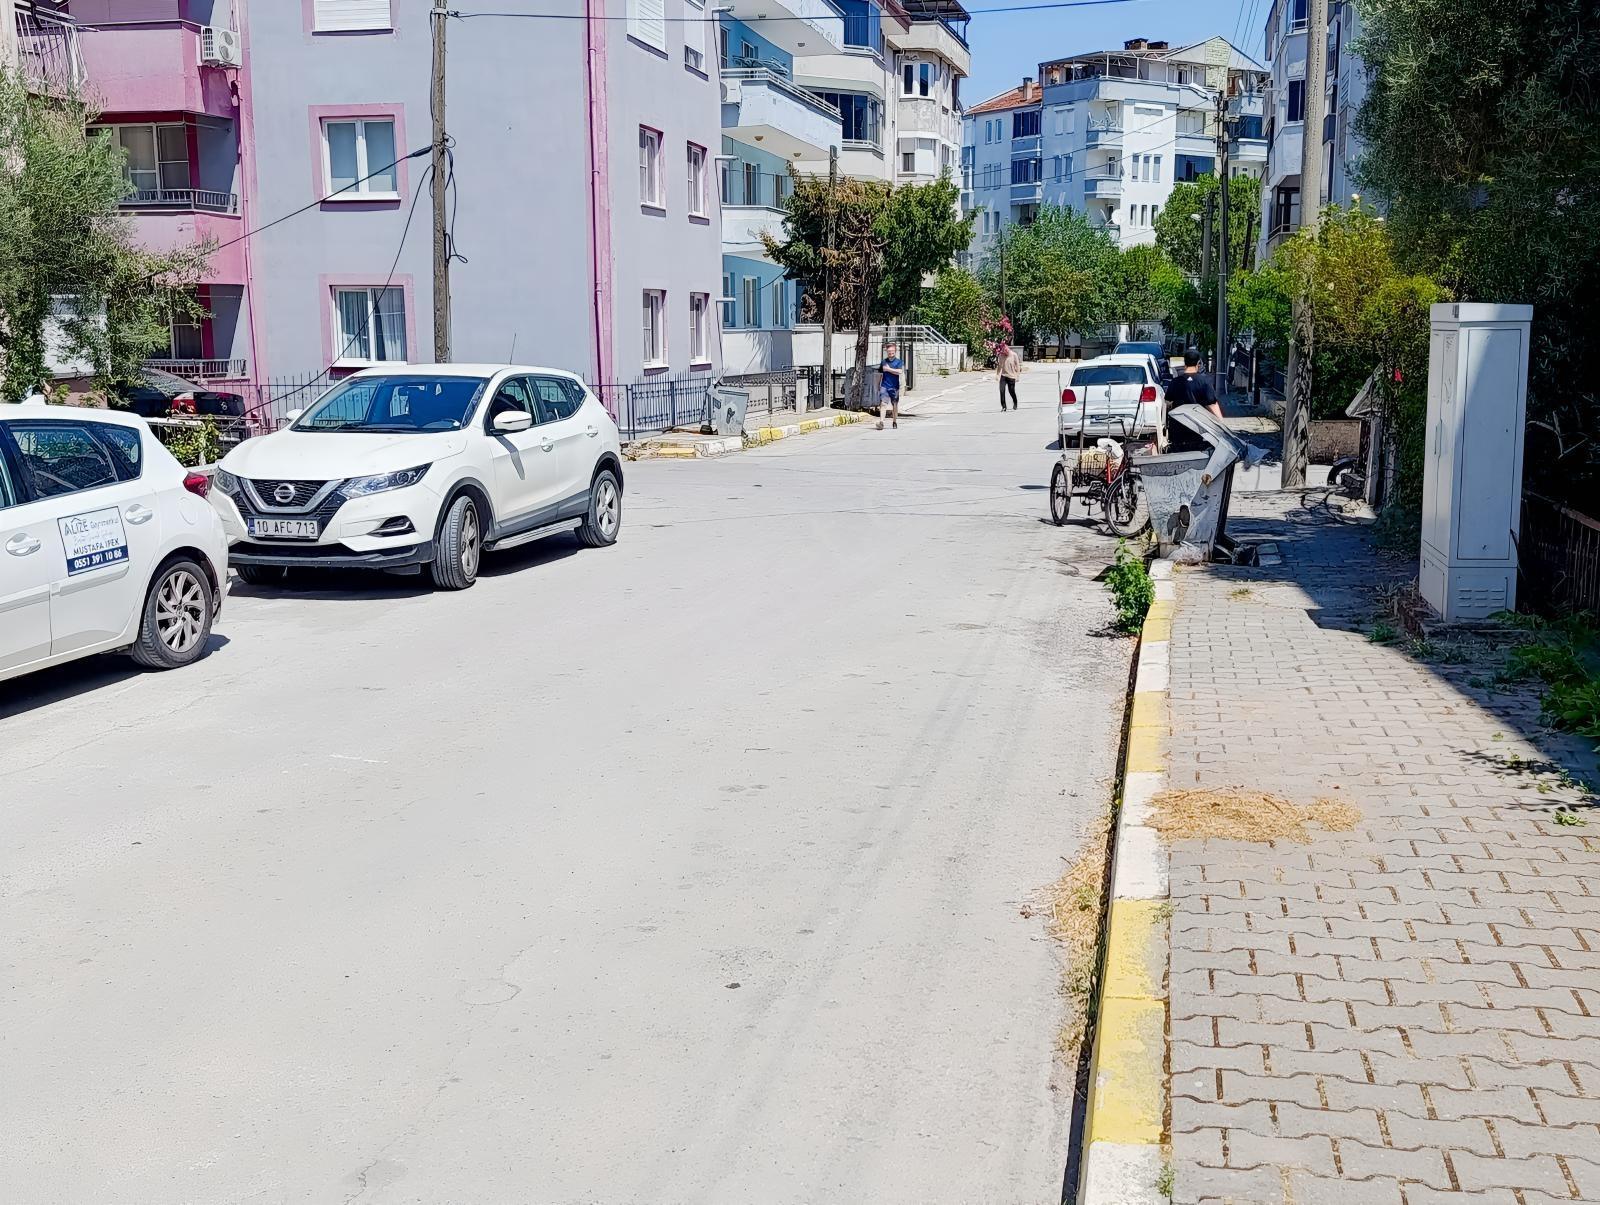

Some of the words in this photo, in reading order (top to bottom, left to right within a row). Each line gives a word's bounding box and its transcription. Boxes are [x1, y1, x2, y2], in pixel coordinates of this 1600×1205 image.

[257, 521, 268, 532] 10
[274, 521, 292, 534] AFC
[296, 522, 315, 534] 713
[74, 542, 104, 556] MUSTAFA
[74, 557, 90, 569] 0551
[92, 553, 104, 563] 391
[105, 551, 112, 561] 10
